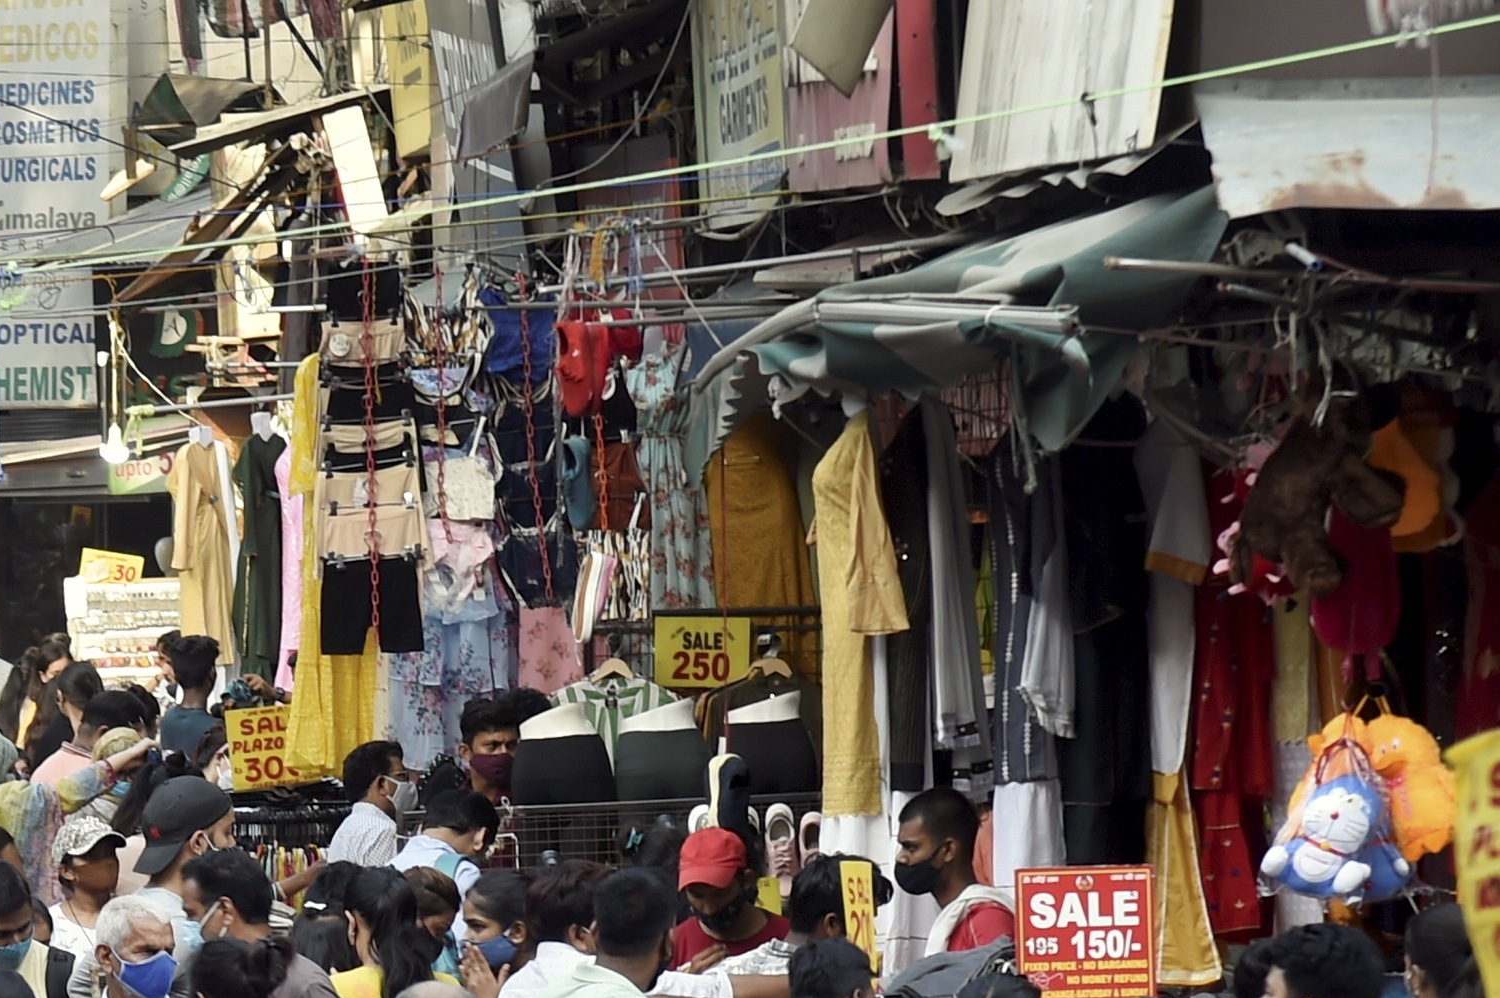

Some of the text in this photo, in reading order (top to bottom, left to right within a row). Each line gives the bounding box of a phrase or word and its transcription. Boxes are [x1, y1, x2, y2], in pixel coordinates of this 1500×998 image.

[719, 75, 769, 146] GARMENTS
[115, 459, 153, 480] upto
[683, 631, 722, 650] SALE
[672, 651, 730, 681] 250
[240, 716, 288, 735] SAL
[1030, 891, 1140, 929] SALE
[1071, 929, 1142, 959] 150/-
[1024, 962, 1050, 972] FIXED
[1051, 961, 1077, 971] PRICE
[1083, 961, 1097, 970] NO
[1066, 973, 1148, 985] NO MONEY REFUND
[1120, 987, 1149, 998] SUNDAY
